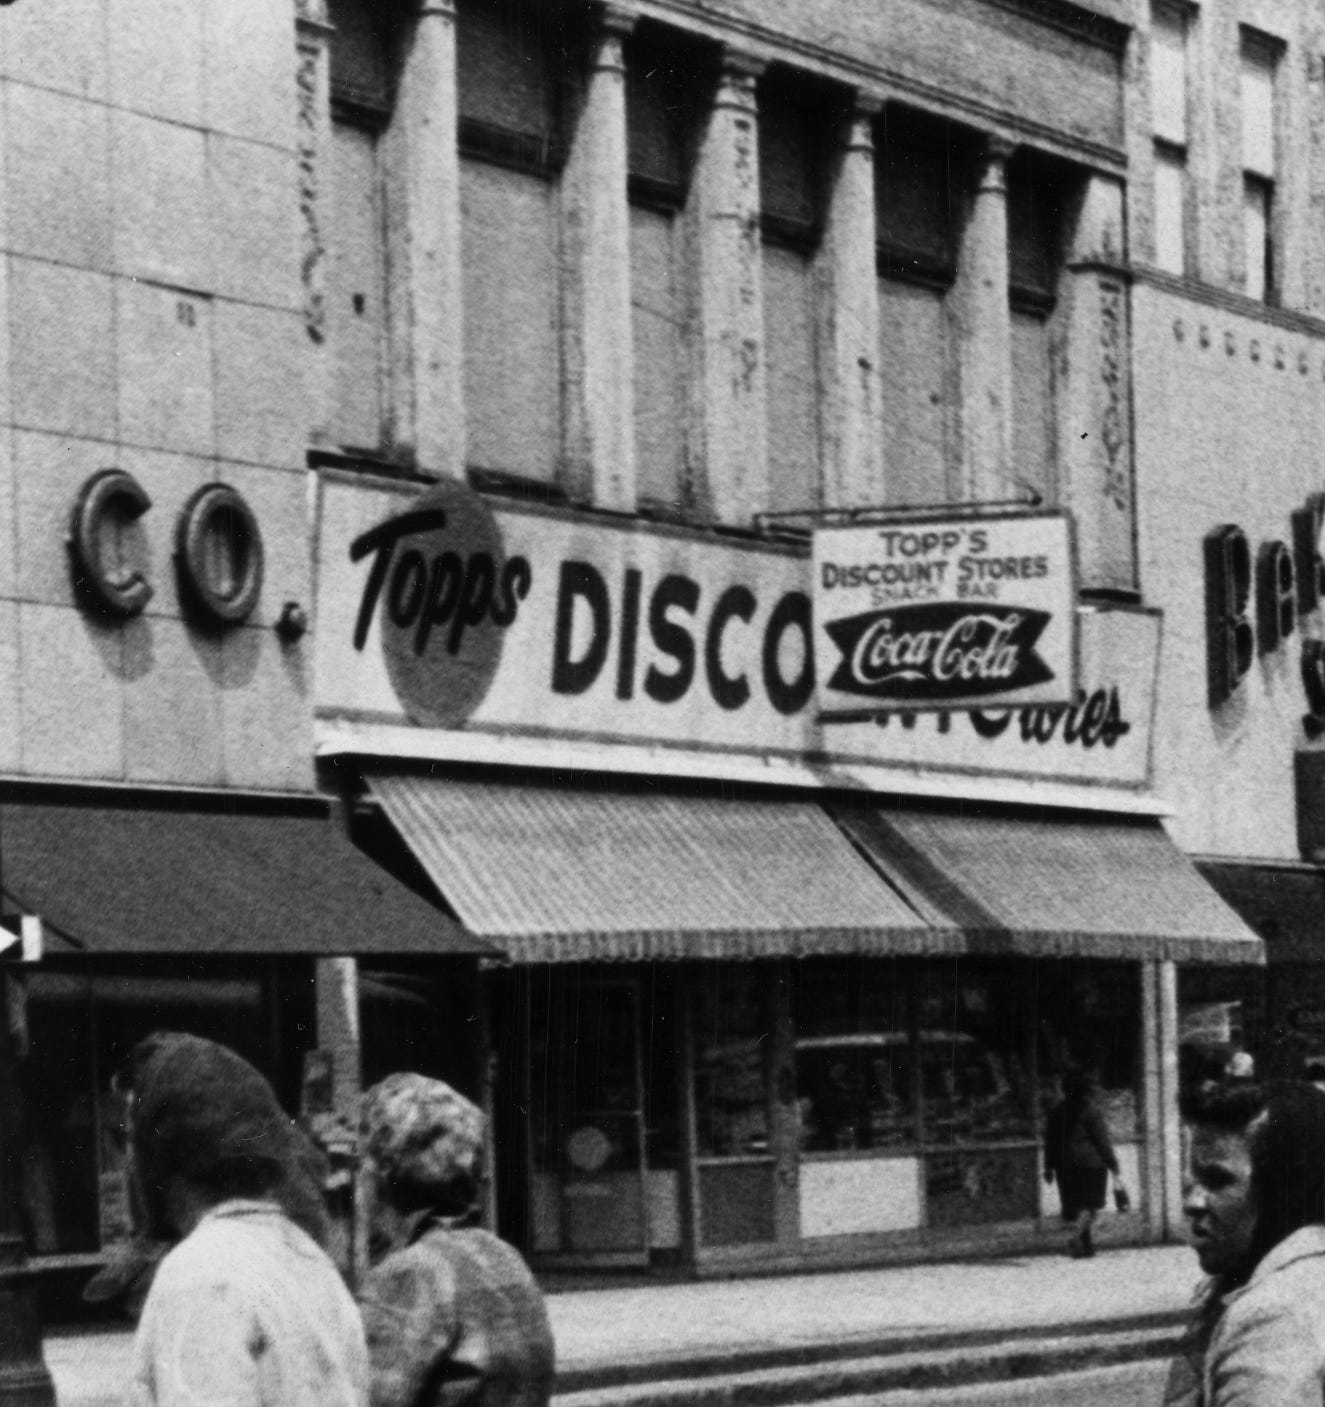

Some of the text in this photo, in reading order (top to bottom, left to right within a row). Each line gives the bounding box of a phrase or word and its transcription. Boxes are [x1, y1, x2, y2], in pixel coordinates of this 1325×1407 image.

[879, 530, 989, 558] TOPP'S
[350, 507, 532, 656] Topps
[821, 556, 1049, 589] DISCOUNT STORES
